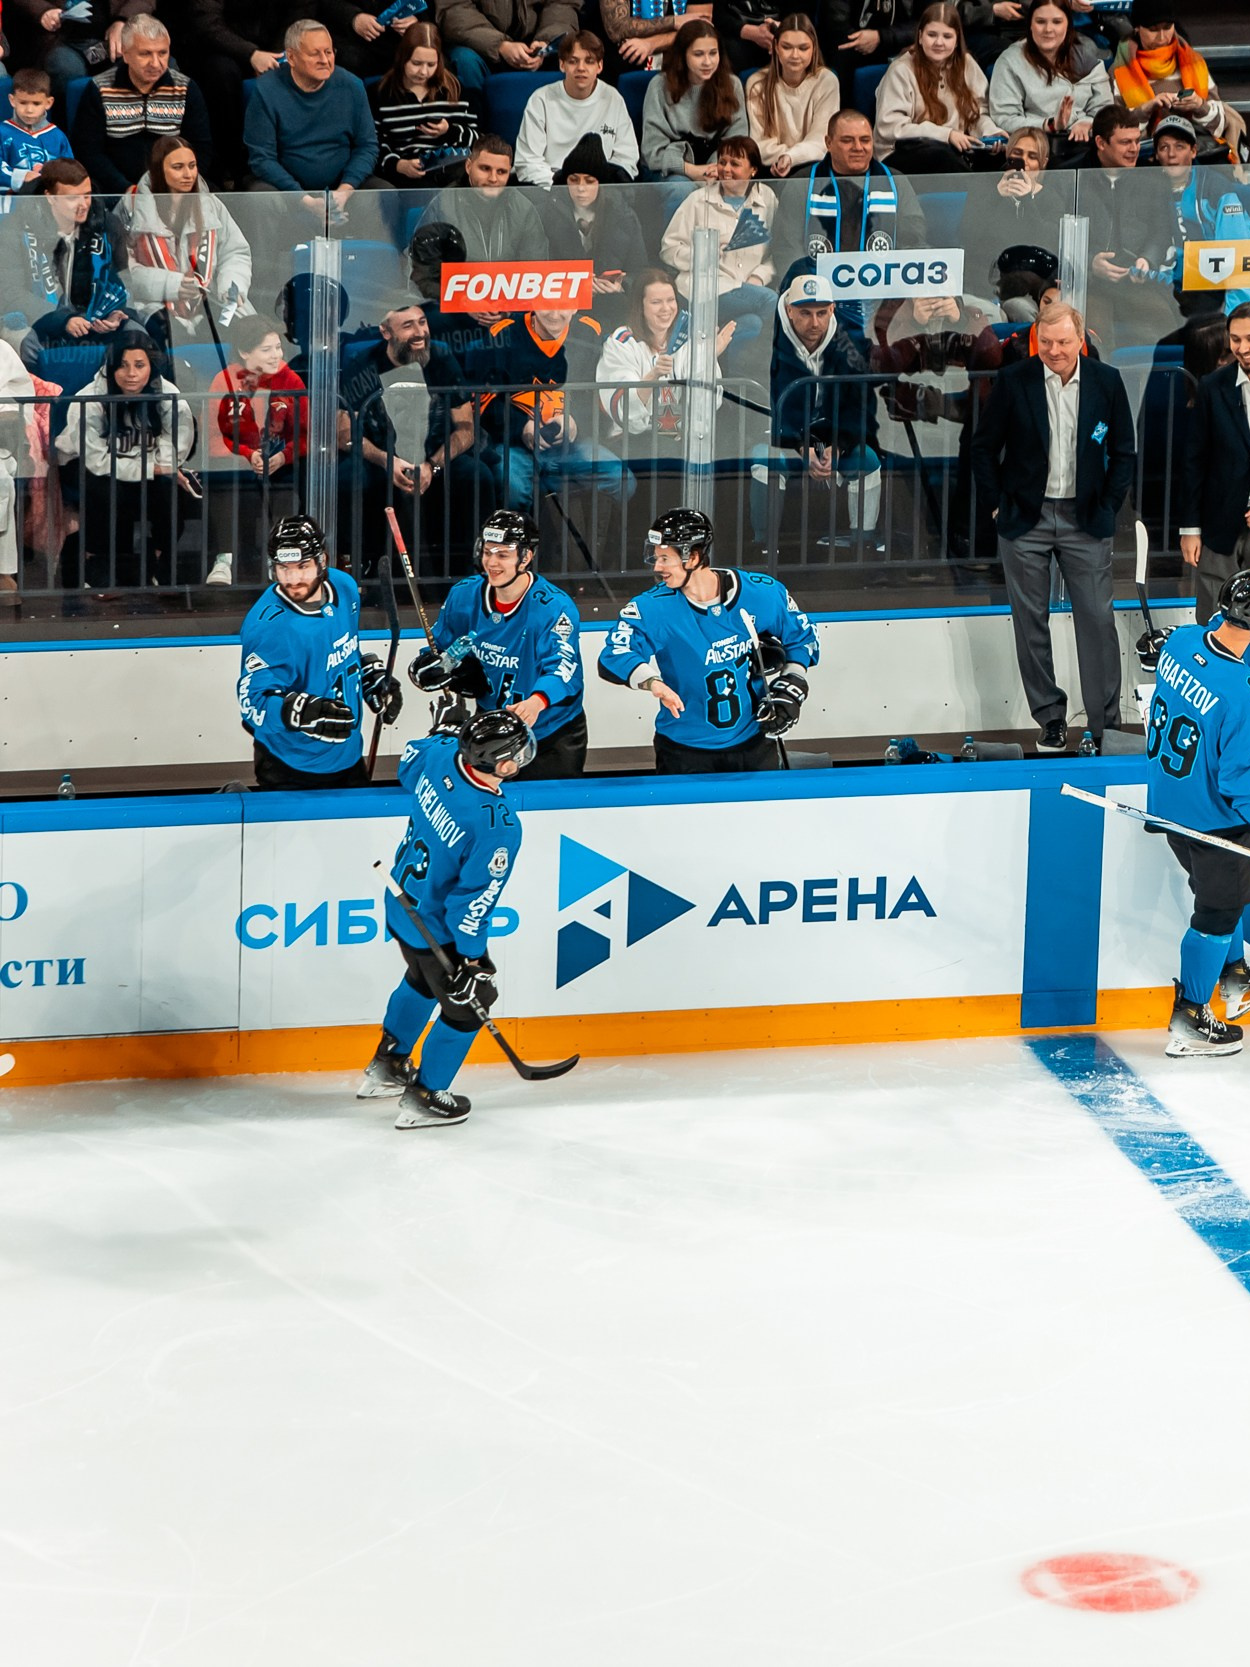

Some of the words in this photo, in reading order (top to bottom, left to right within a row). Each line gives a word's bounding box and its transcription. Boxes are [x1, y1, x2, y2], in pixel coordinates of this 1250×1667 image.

[443, 271, 590, 302] FONBET
[402, 550, 415, 578] CM
[259, 604, 285, 624] 17
[480, 641, 507, 653] FONBET
[711, 634, 739, 649] FONBET
[772, 680, 806, 702] CC
[1157, 649, 1219, 716] KHAFIZOV
[290, 692, 310, 728] CC
[1147, 695, 1202, 780] 89
[481, 803, 515, 829] 72
[235, 898, 520, 949] СИБЬ
[707, 875, 938, 927] АРЕНА
[0, 958, 87, 988] сти
